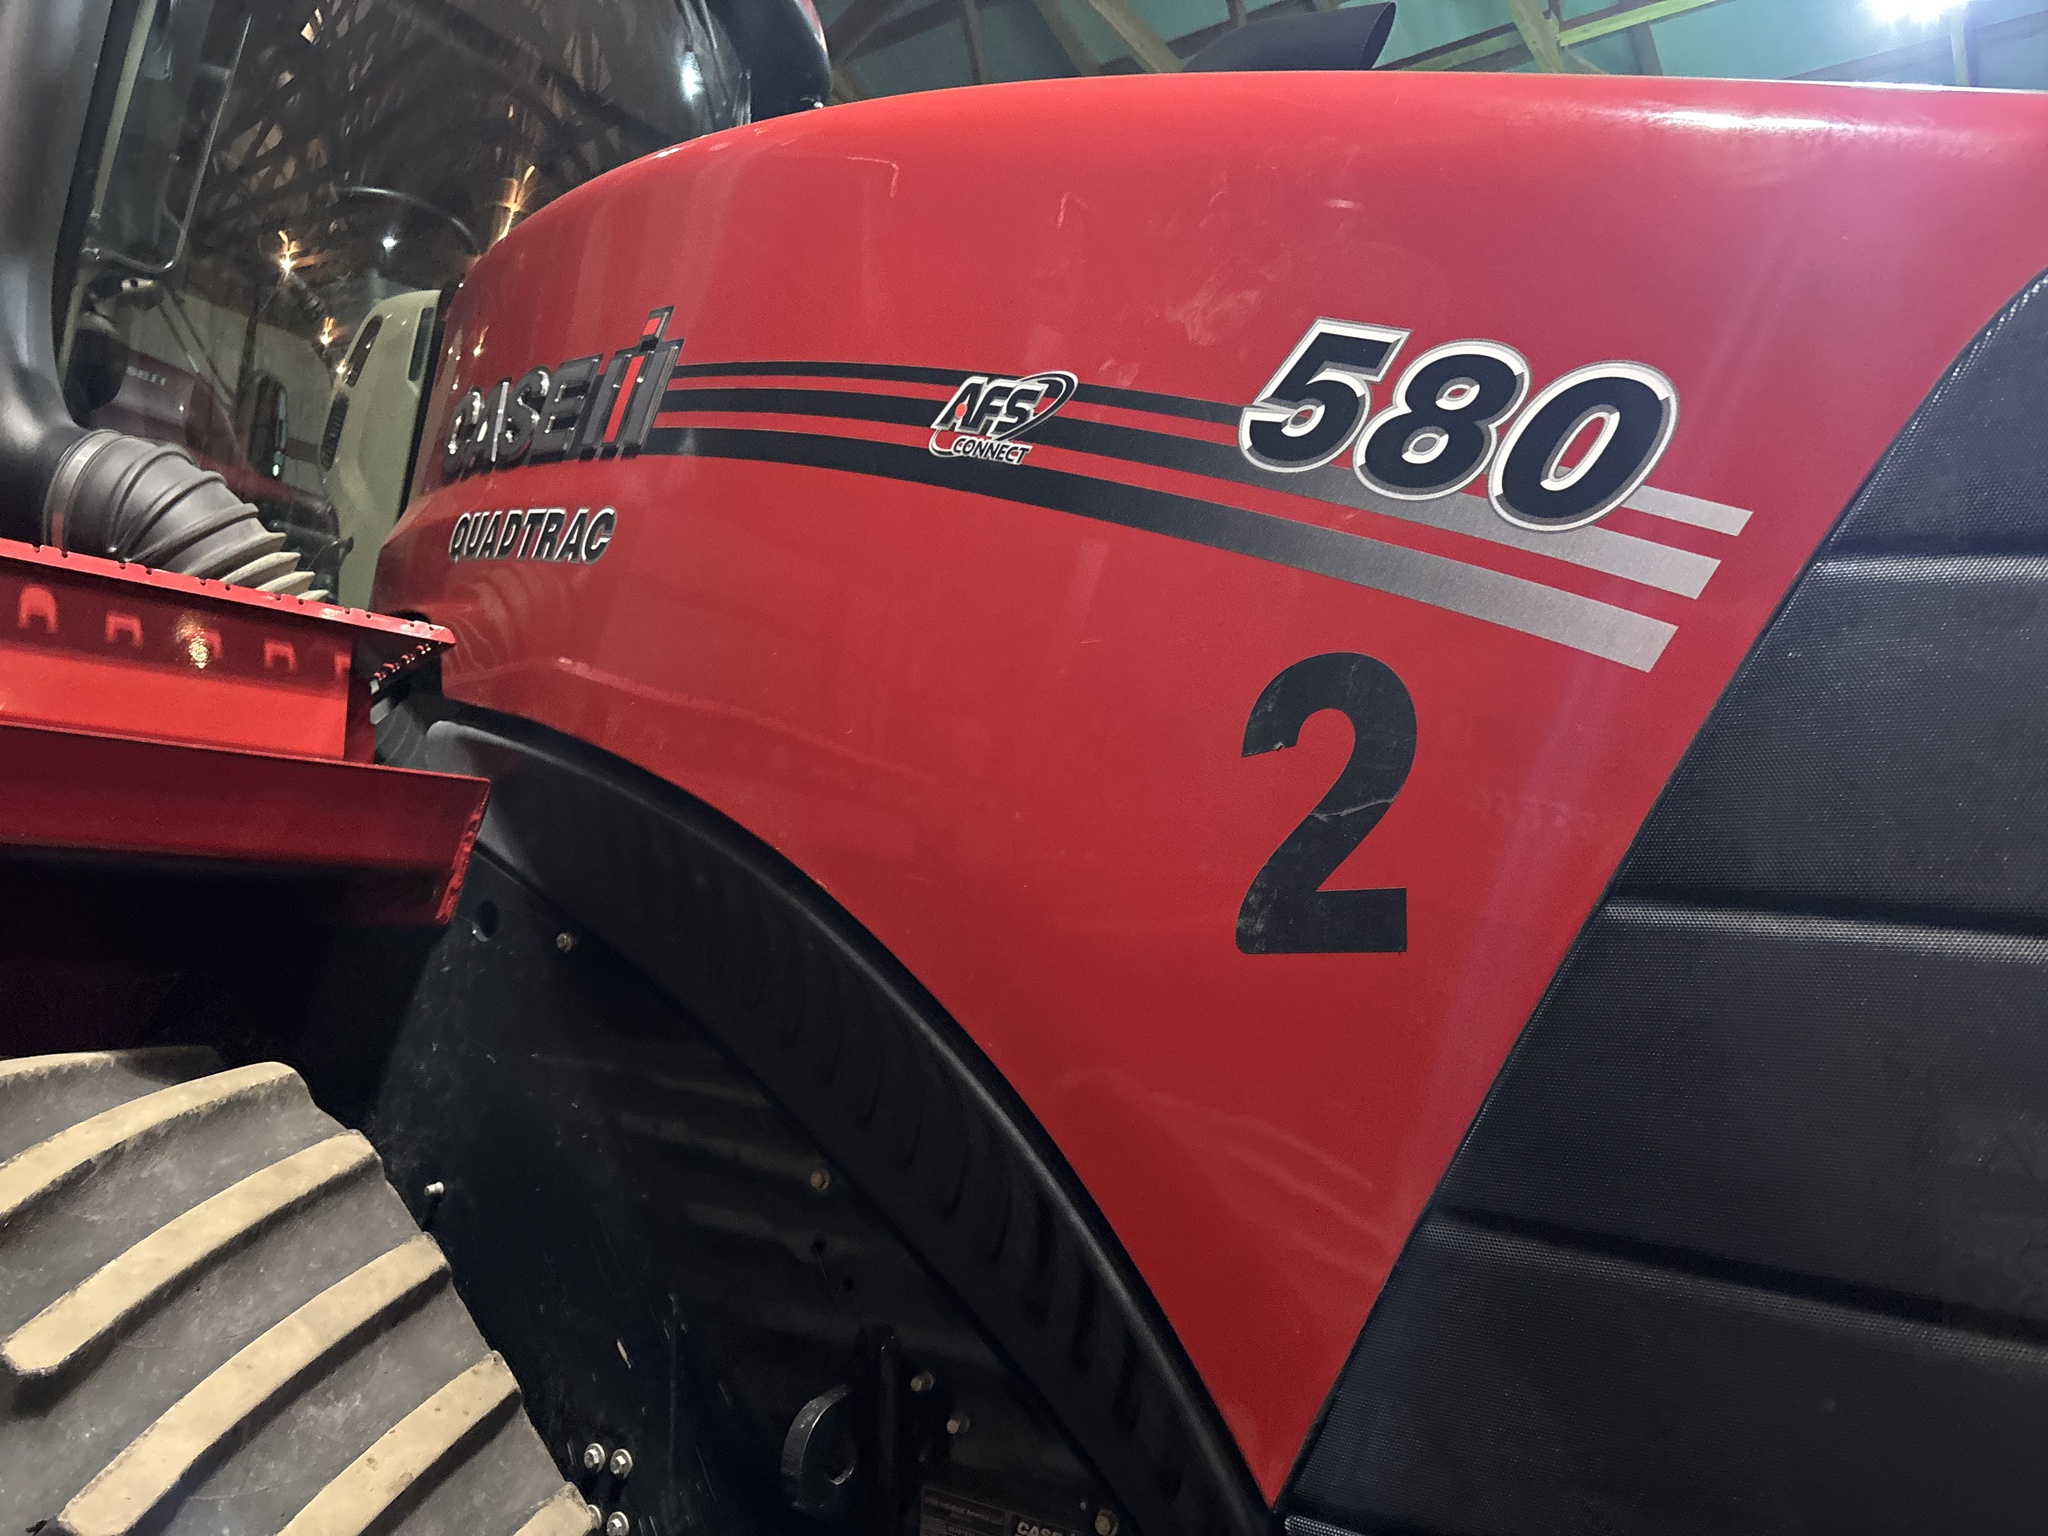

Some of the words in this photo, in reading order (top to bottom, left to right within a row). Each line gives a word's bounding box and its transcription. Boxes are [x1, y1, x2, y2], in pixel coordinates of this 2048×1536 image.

[930, 376, 1049, 437] AFS
[1237, 317, 1681, 533] 580
[953, 436, 1033, 465] CONNECT
[449, 506, 617, 564] QUADTRAC
[1235, 651, 1417, 954] 2
